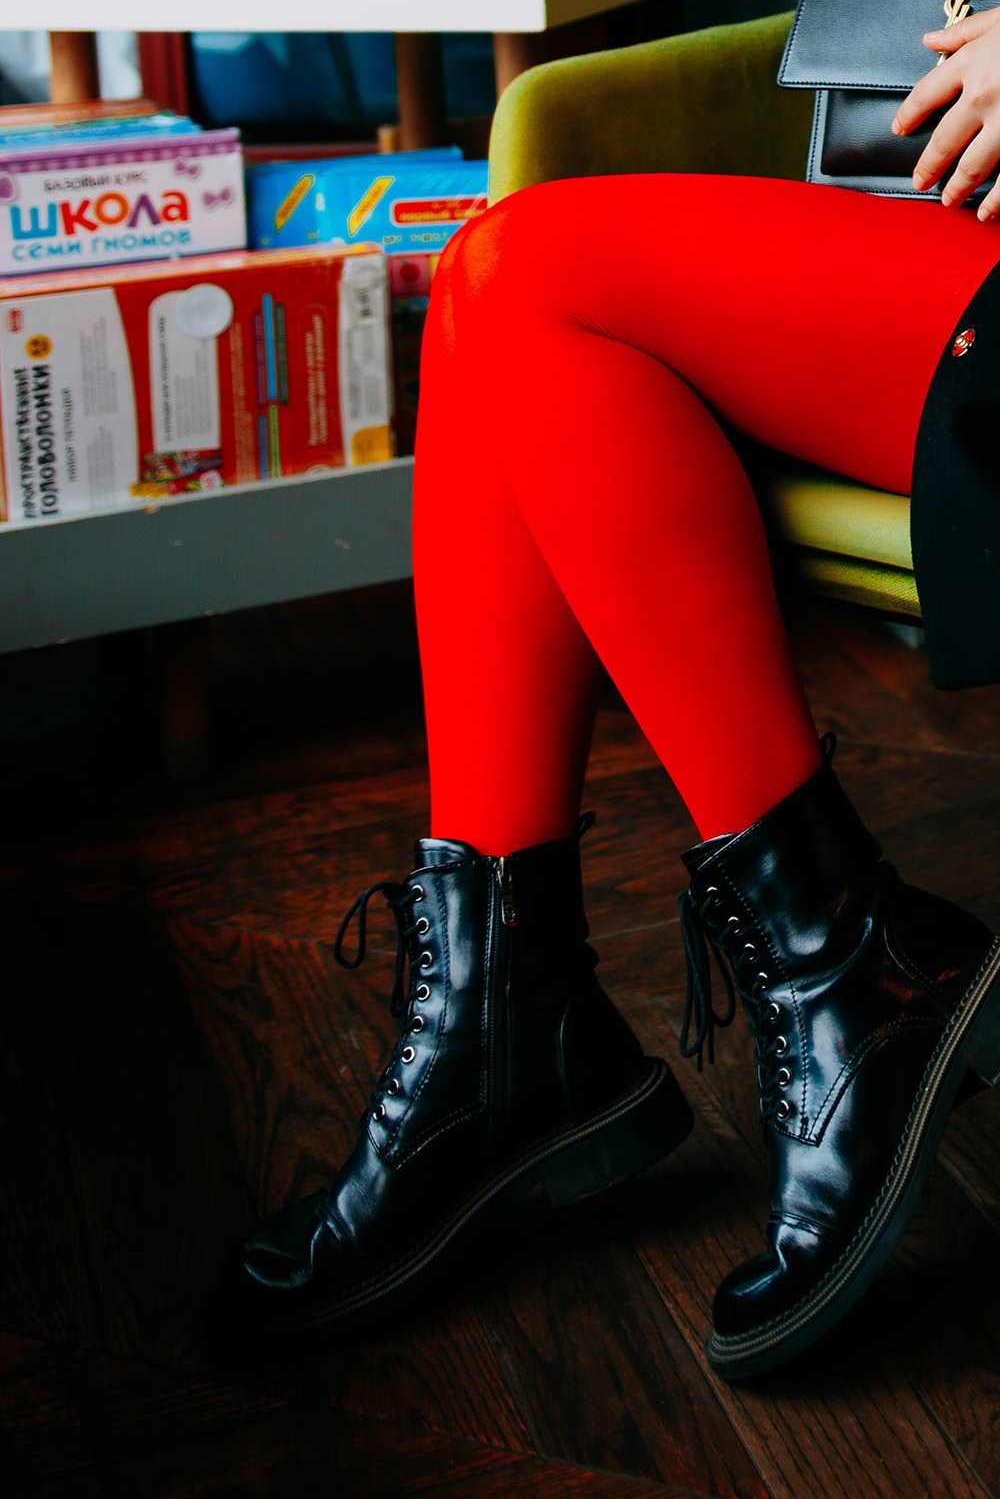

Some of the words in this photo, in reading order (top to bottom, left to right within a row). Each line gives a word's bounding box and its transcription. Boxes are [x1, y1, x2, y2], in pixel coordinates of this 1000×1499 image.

[12, 240, 81, 261] СЕМИ
[91, 229, 191, 253] ГНОМОВ
[31, 364, 60, 516] ГОЛОВОЛОМКИ
